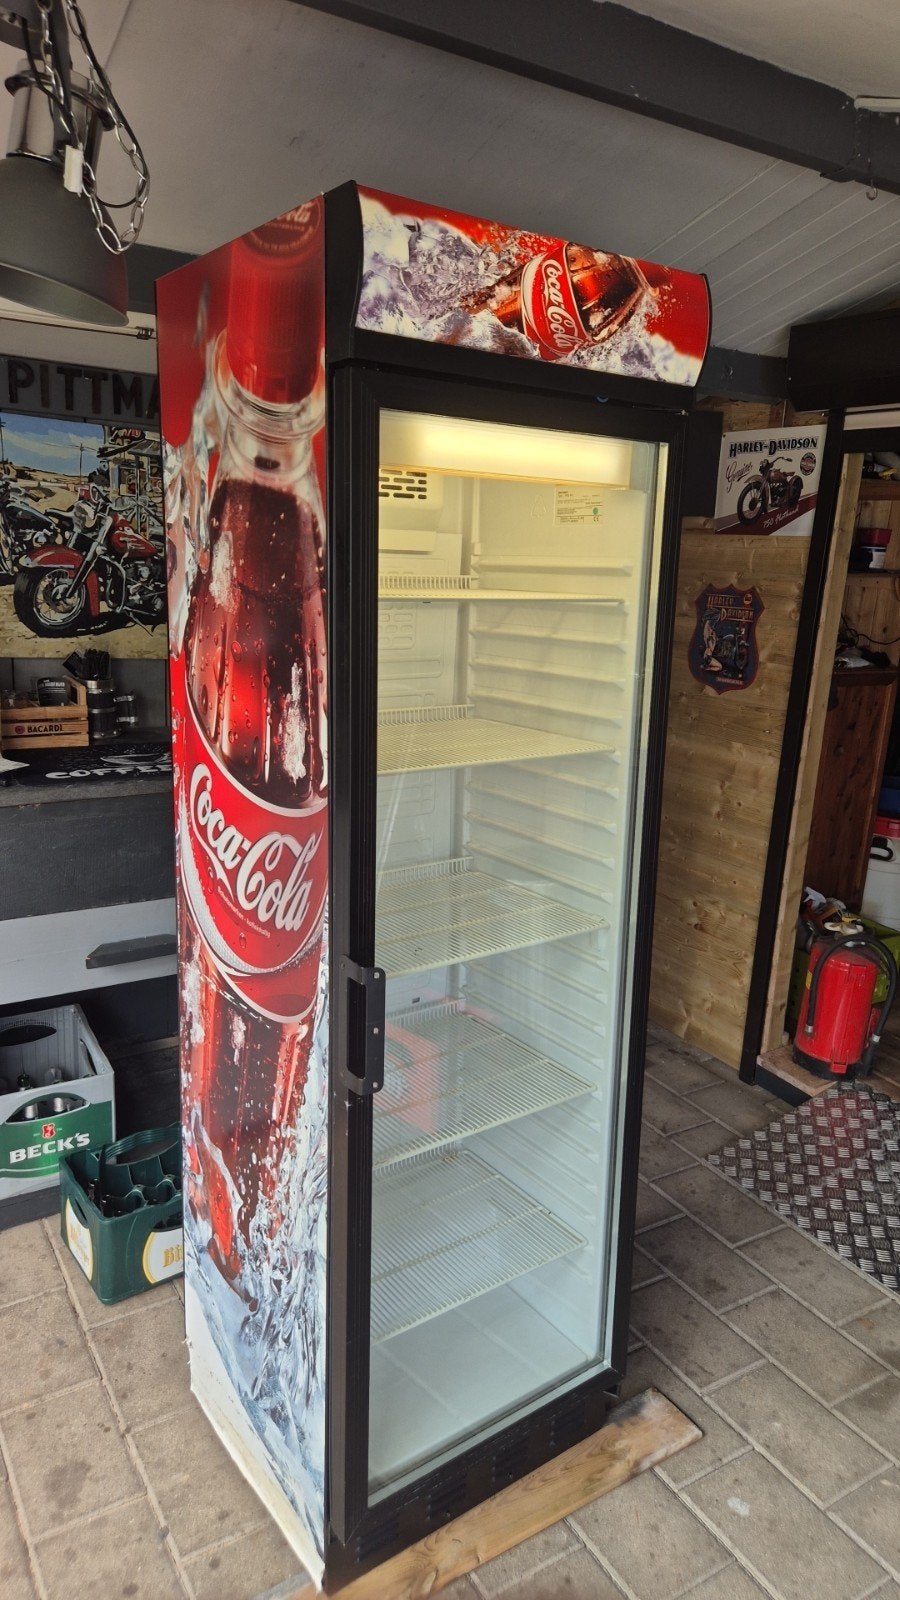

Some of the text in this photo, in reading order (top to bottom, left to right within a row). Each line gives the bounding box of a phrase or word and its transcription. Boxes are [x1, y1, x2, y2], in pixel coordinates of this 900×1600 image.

[541, 259, 582, 348] Coca-Cola
[729, 438, 818, 457] HARLEY-DAVIDSON
[190, 763, 324, 932] Coca-Cola
[9, 1133, 90, 1164] BECK'S
